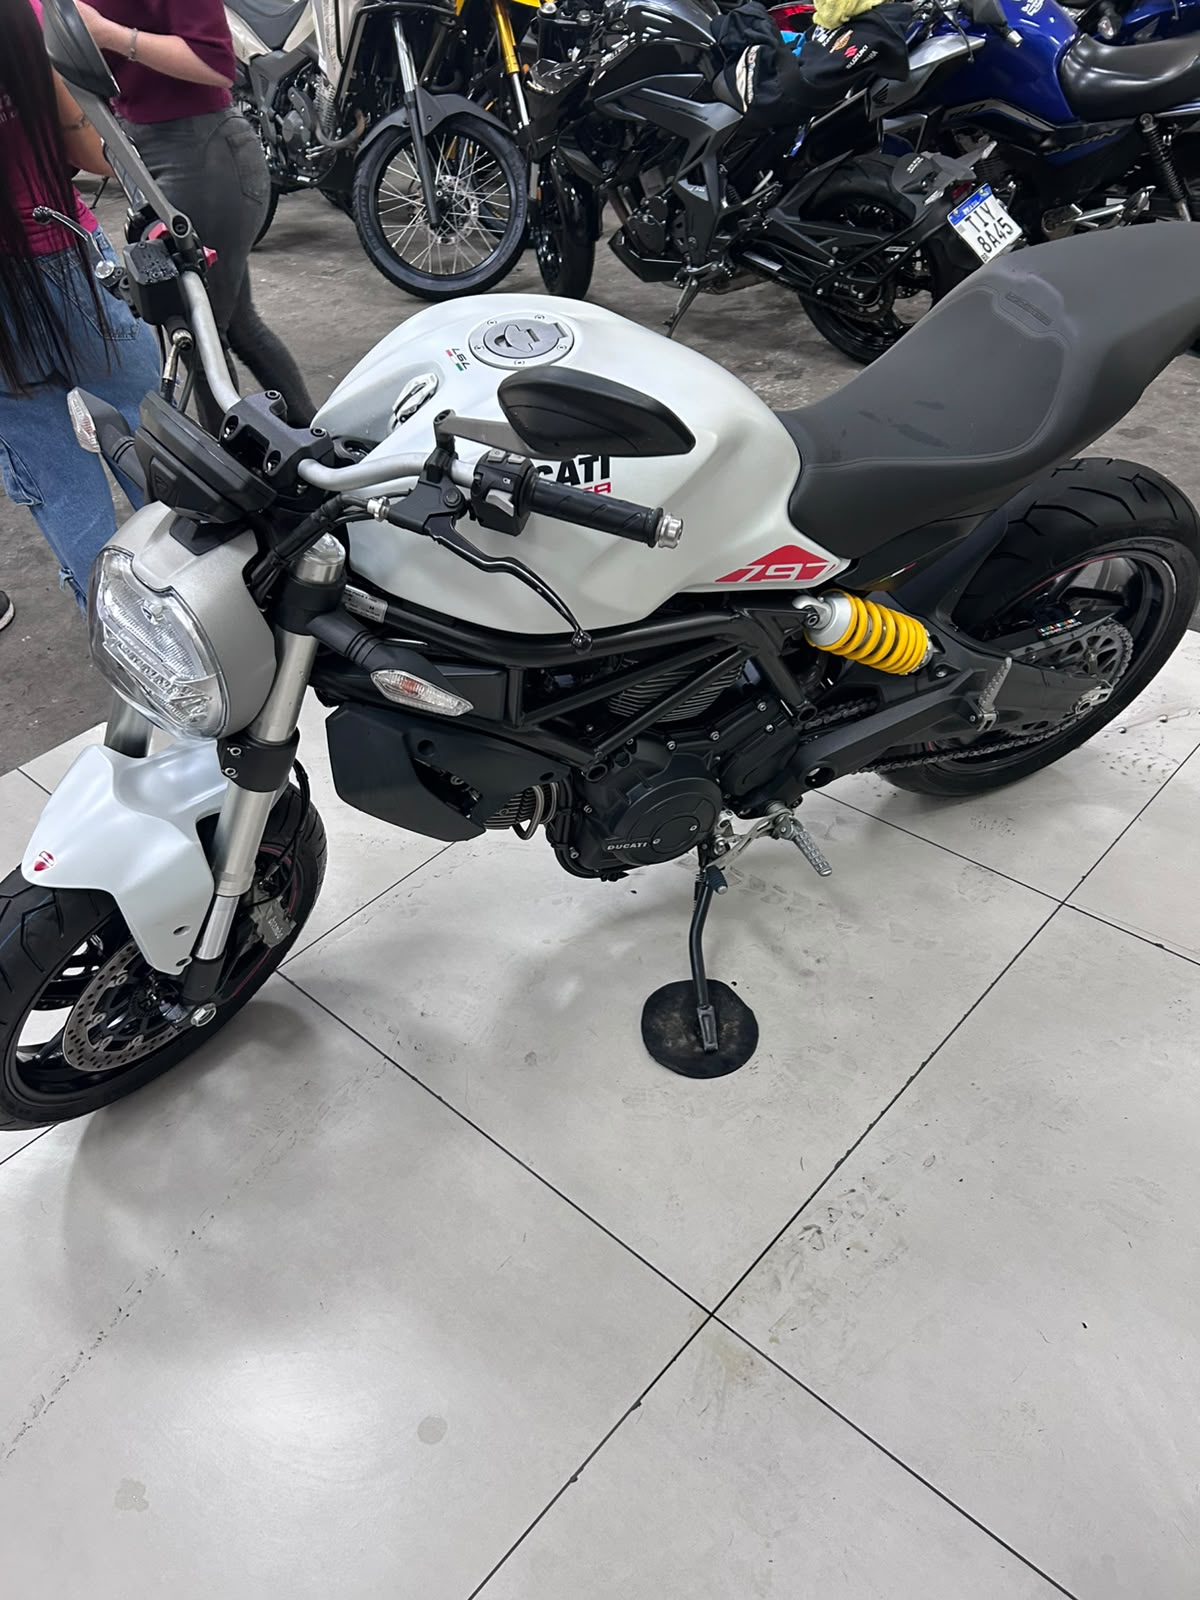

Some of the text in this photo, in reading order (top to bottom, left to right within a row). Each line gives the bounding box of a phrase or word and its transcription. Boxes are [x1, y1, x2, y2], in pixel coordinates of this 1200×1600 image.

[846, 44, 868, 69] SUZUKI
[965, 202, 996, 233] TIY
[977, 217, 1014, 253] 8A45
[534, 454, 611, 486] CATI
[738, 562, 837, 583] 797
[607, 842, 647, 851] DUCATI
